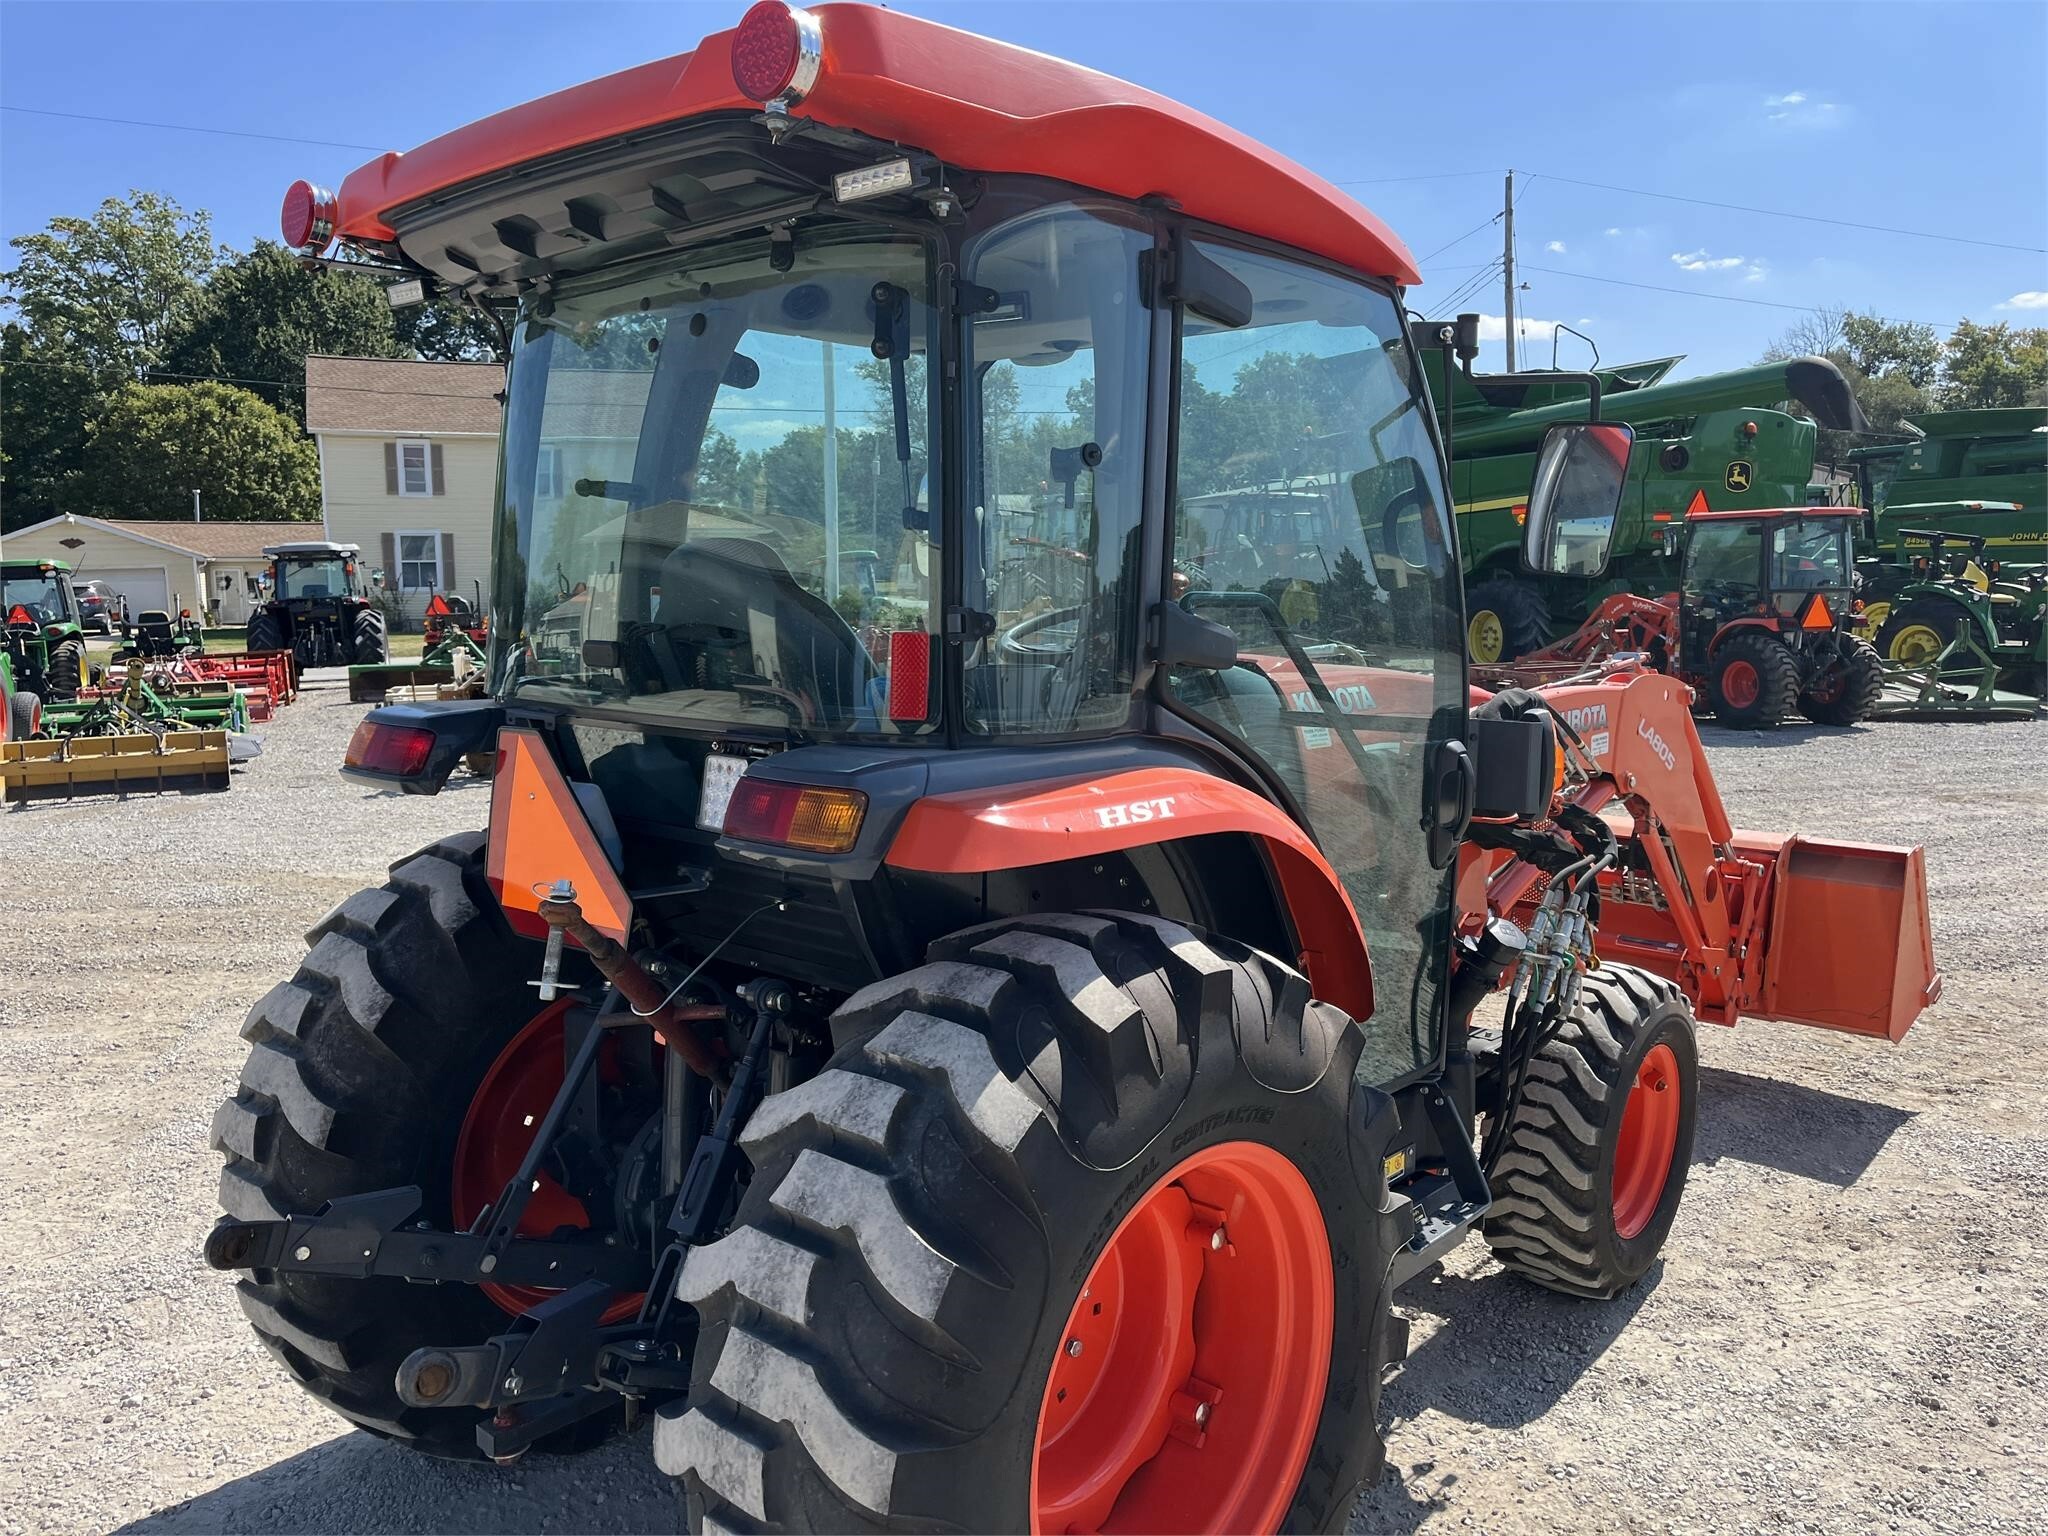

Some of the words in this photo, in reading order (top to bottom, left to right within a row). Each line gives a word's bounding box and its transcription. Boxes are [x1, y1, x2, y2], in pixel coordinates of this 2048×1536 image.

[2009, 532, 2039, 541] JOHN
[1638, 718, 1676, 771] LA805
[1094, 796, 1176, 829] HST
